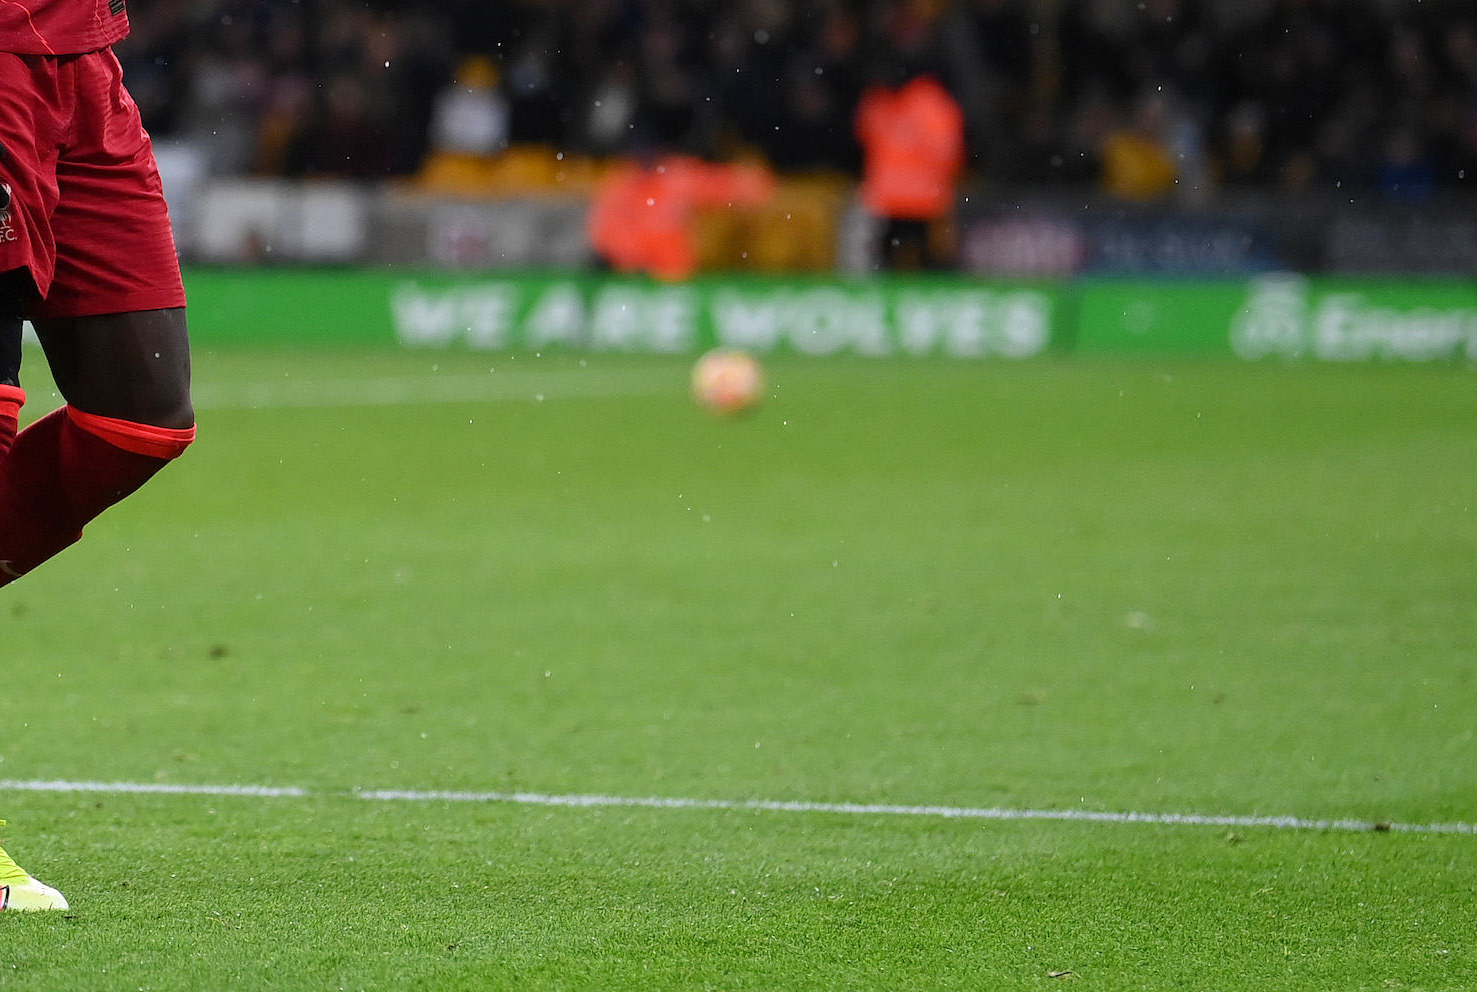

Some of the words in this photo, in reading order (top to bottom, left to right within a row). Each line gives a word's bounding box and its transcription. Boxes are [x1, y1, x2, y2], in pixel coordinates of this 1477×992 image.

[390, 283, 516, 348] WE
[525, 283, 697, 350] ARE
[711, 288, 1054, 357] WOLVES
